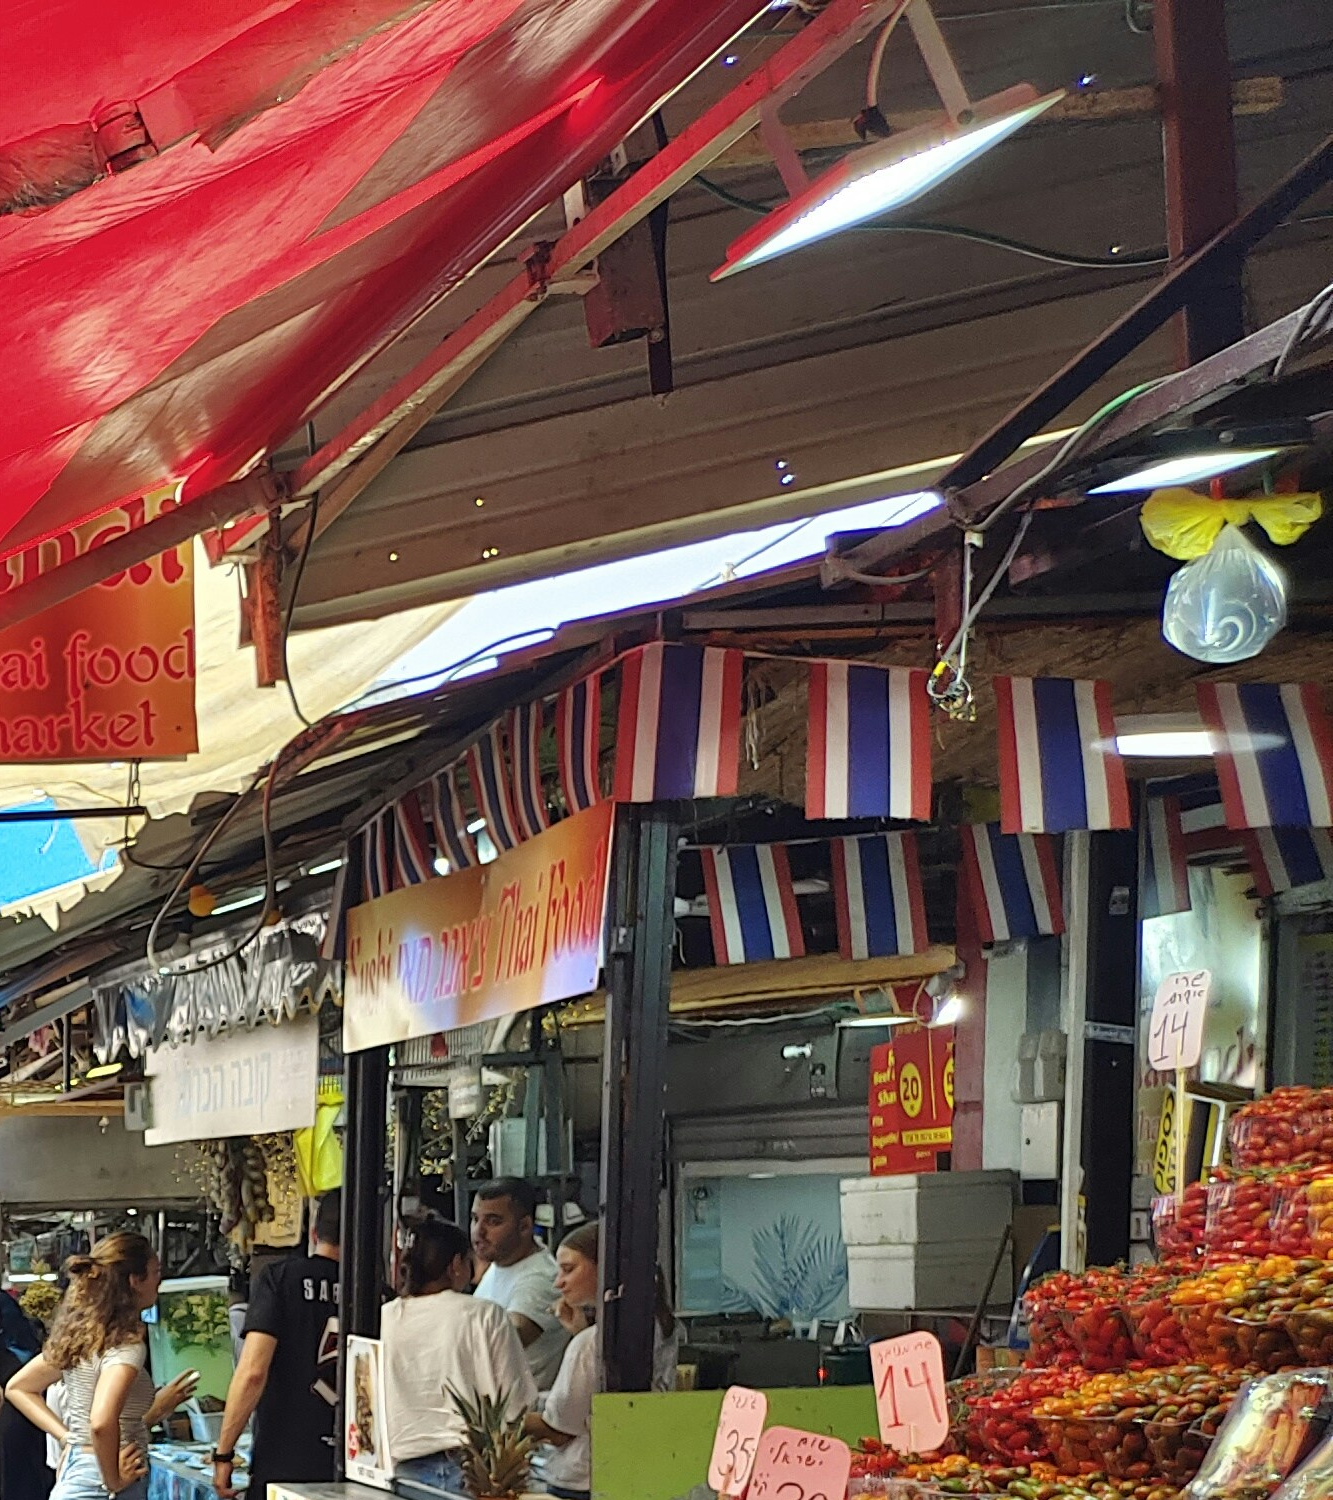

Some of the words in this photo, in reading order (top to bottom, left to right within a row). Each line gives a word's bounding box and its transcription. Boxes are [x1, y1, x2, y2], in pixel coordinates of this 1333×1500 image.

[65, 630, 195, 699] food
[495, 871, 543, 983] Thai
[1153, 1011, 1189, 1063] 14
[901, 1077, 920, 1101] 20
[879, 1361, 942, 1429] 14
[717, 1429, 756, 1484] 35
